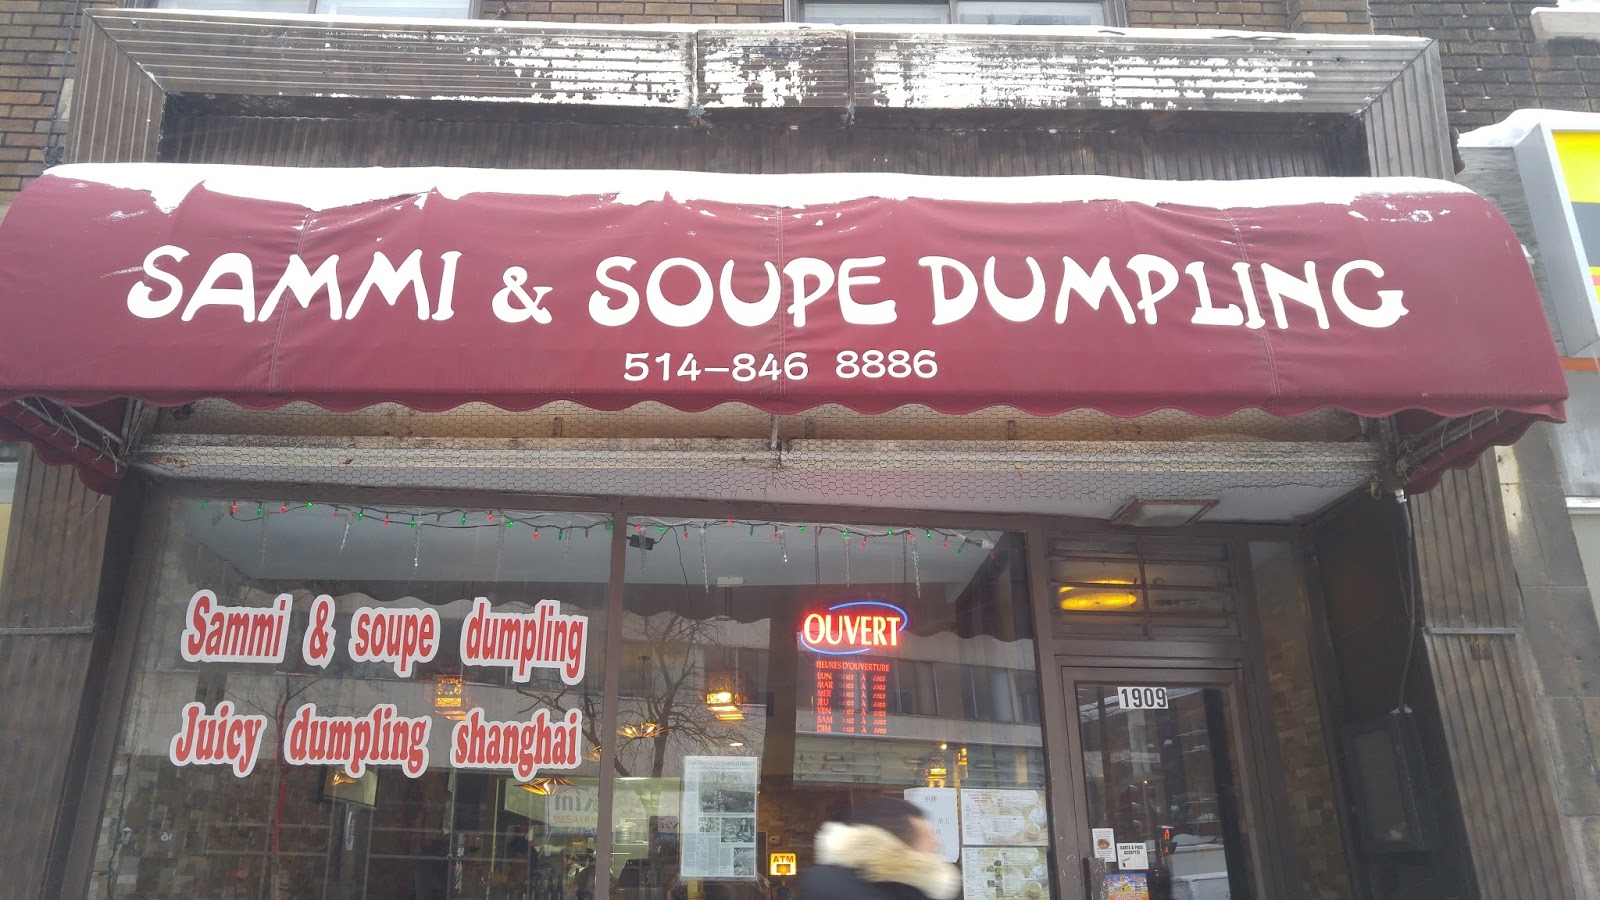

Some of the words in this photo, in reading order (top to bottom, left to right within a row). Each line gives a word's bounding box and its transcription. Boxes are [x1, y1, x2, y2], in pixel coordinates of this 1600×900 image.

[127, 245, 463, 323] SAMMI
[491, 265, 553, 325] &
[588, 256, 898, 328] SOUPE
[918, 254, 1410, 330] DUMPLING
[835, 349, 938, 379] 8886
[803, 613, 901, 647] OUVERT
[187, 595, 286, 656] Sammi
[308, 600, 330, 660] &
[354, 613, 435, 673] soupe
[465, 602, 584, 680] dumpling
[816, 660, 842, 670] HEURES
[842, 662, 890, 672] D'OUVERTURE
[817, 672, 832, 680] LUN
[817, 681, 833, 689] MAR
[1121, 688, 1167, 709] 1909
[817, 707, 831, 715] VEN
[817, 716, 833, 724] SAM
[817, 725, 832, 733] DIM
[175, 705, 262, 773] Juicy
[289, 707, 428, 775] dumpling
[454, 709, 578, 778] shanghai
[773, 855, 794, 863] ATM
